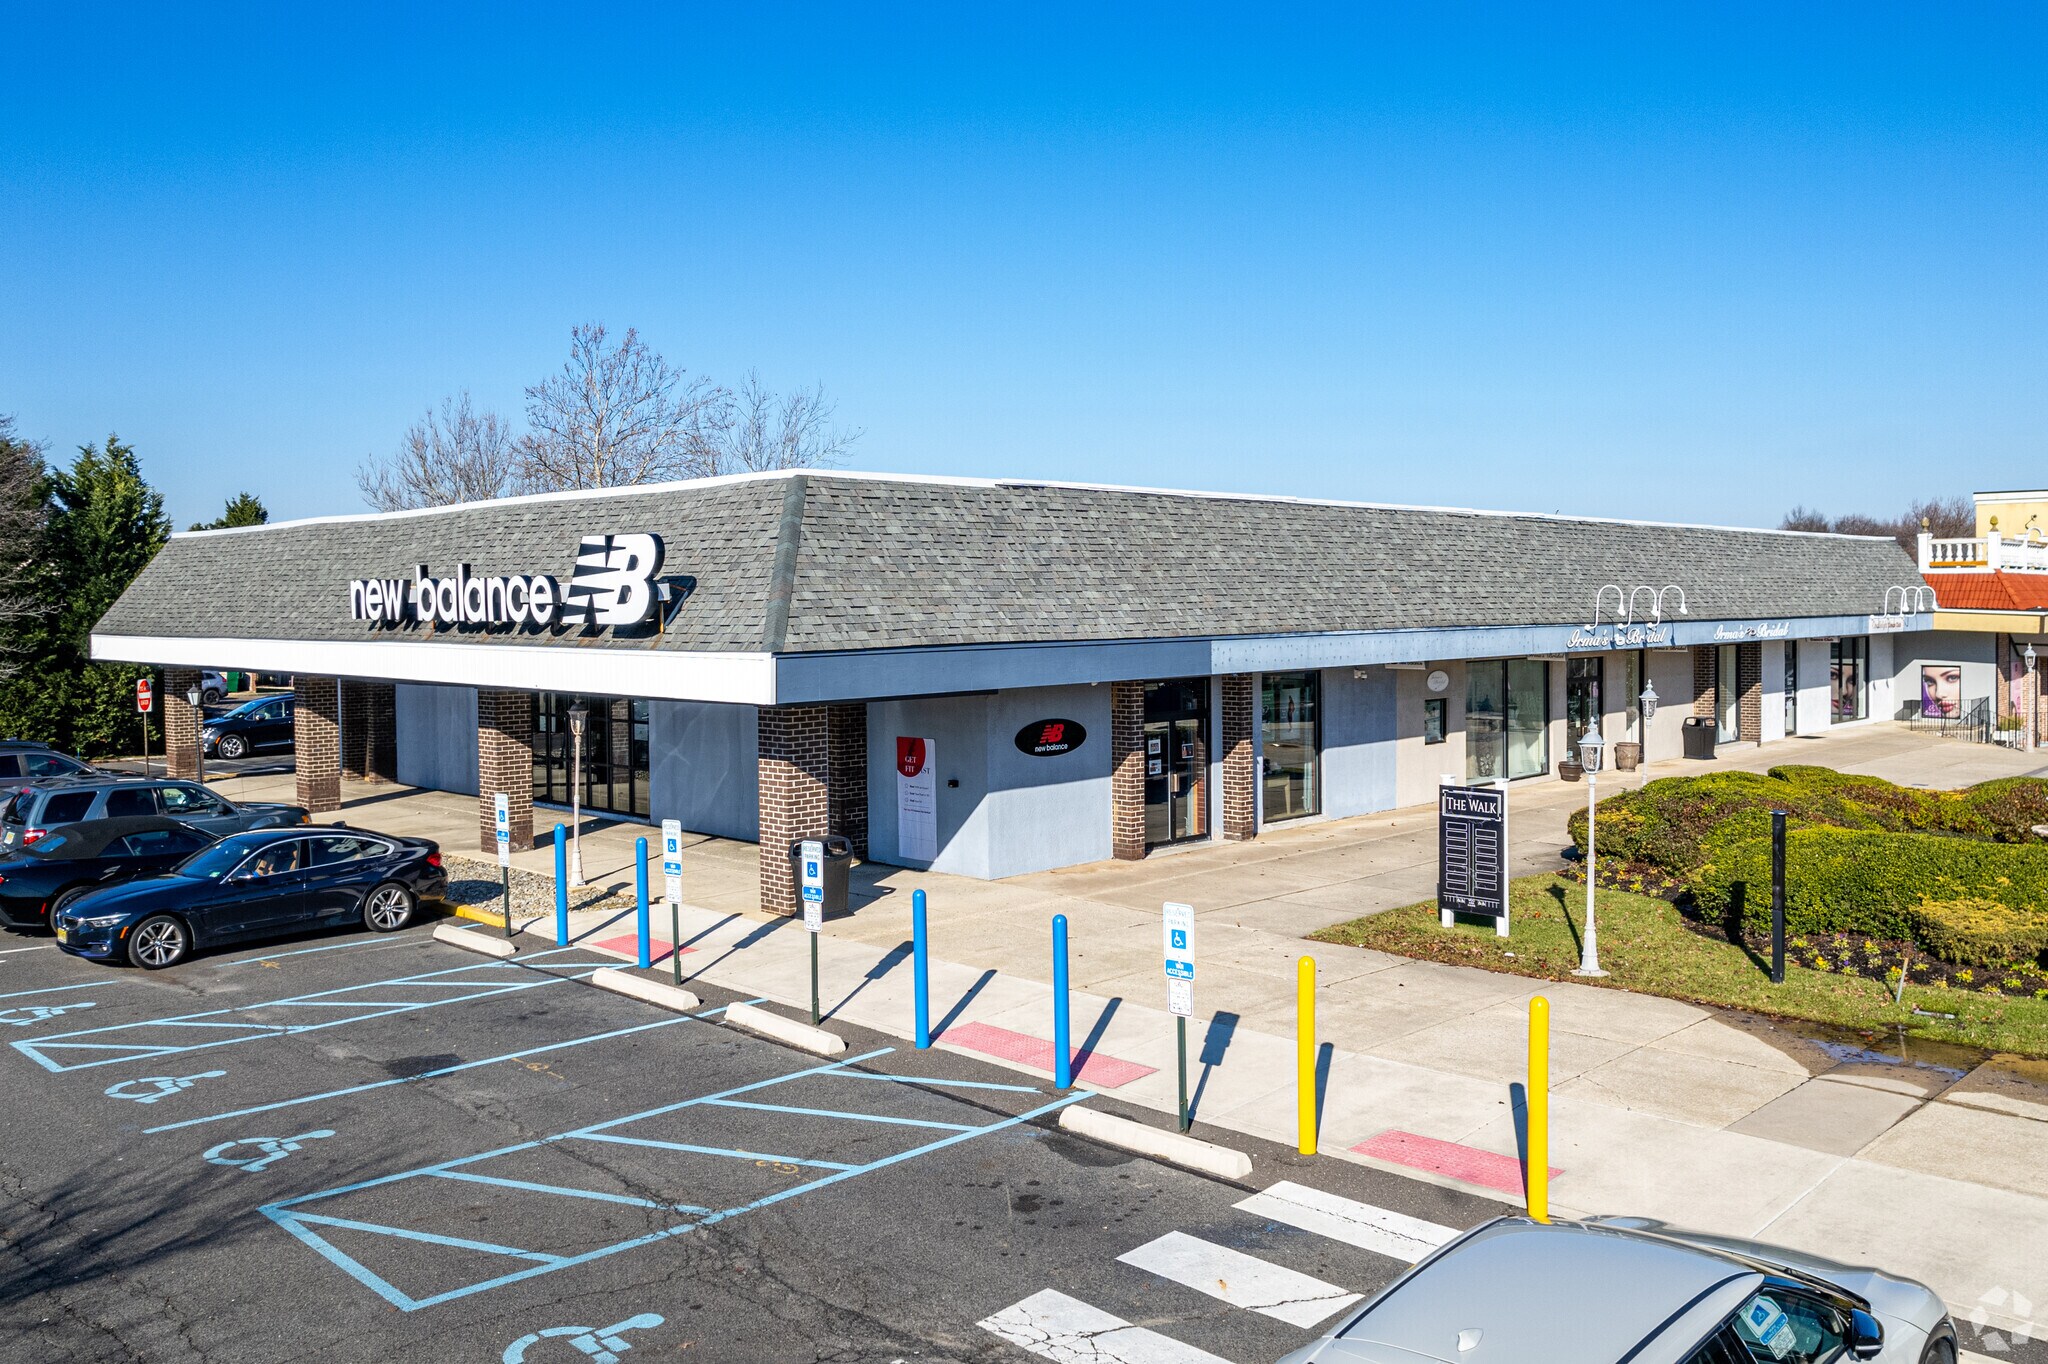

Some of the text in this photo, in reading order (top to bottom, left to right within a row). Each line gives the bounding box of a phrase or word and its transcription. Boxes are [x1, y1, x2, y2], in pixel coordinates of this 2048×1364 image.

[350, 563, 559, 624] new balance
[1757, 622, 1790, 637] Bridal
[1567, 627, 1667, 648] Irma's Bridal
[1046, 743, 1069, 752] balance
[904, 755, 917, 764] GET
[904, 765, 915, 773] FIT
[1446, 797, 1497, 814] THE WALK
